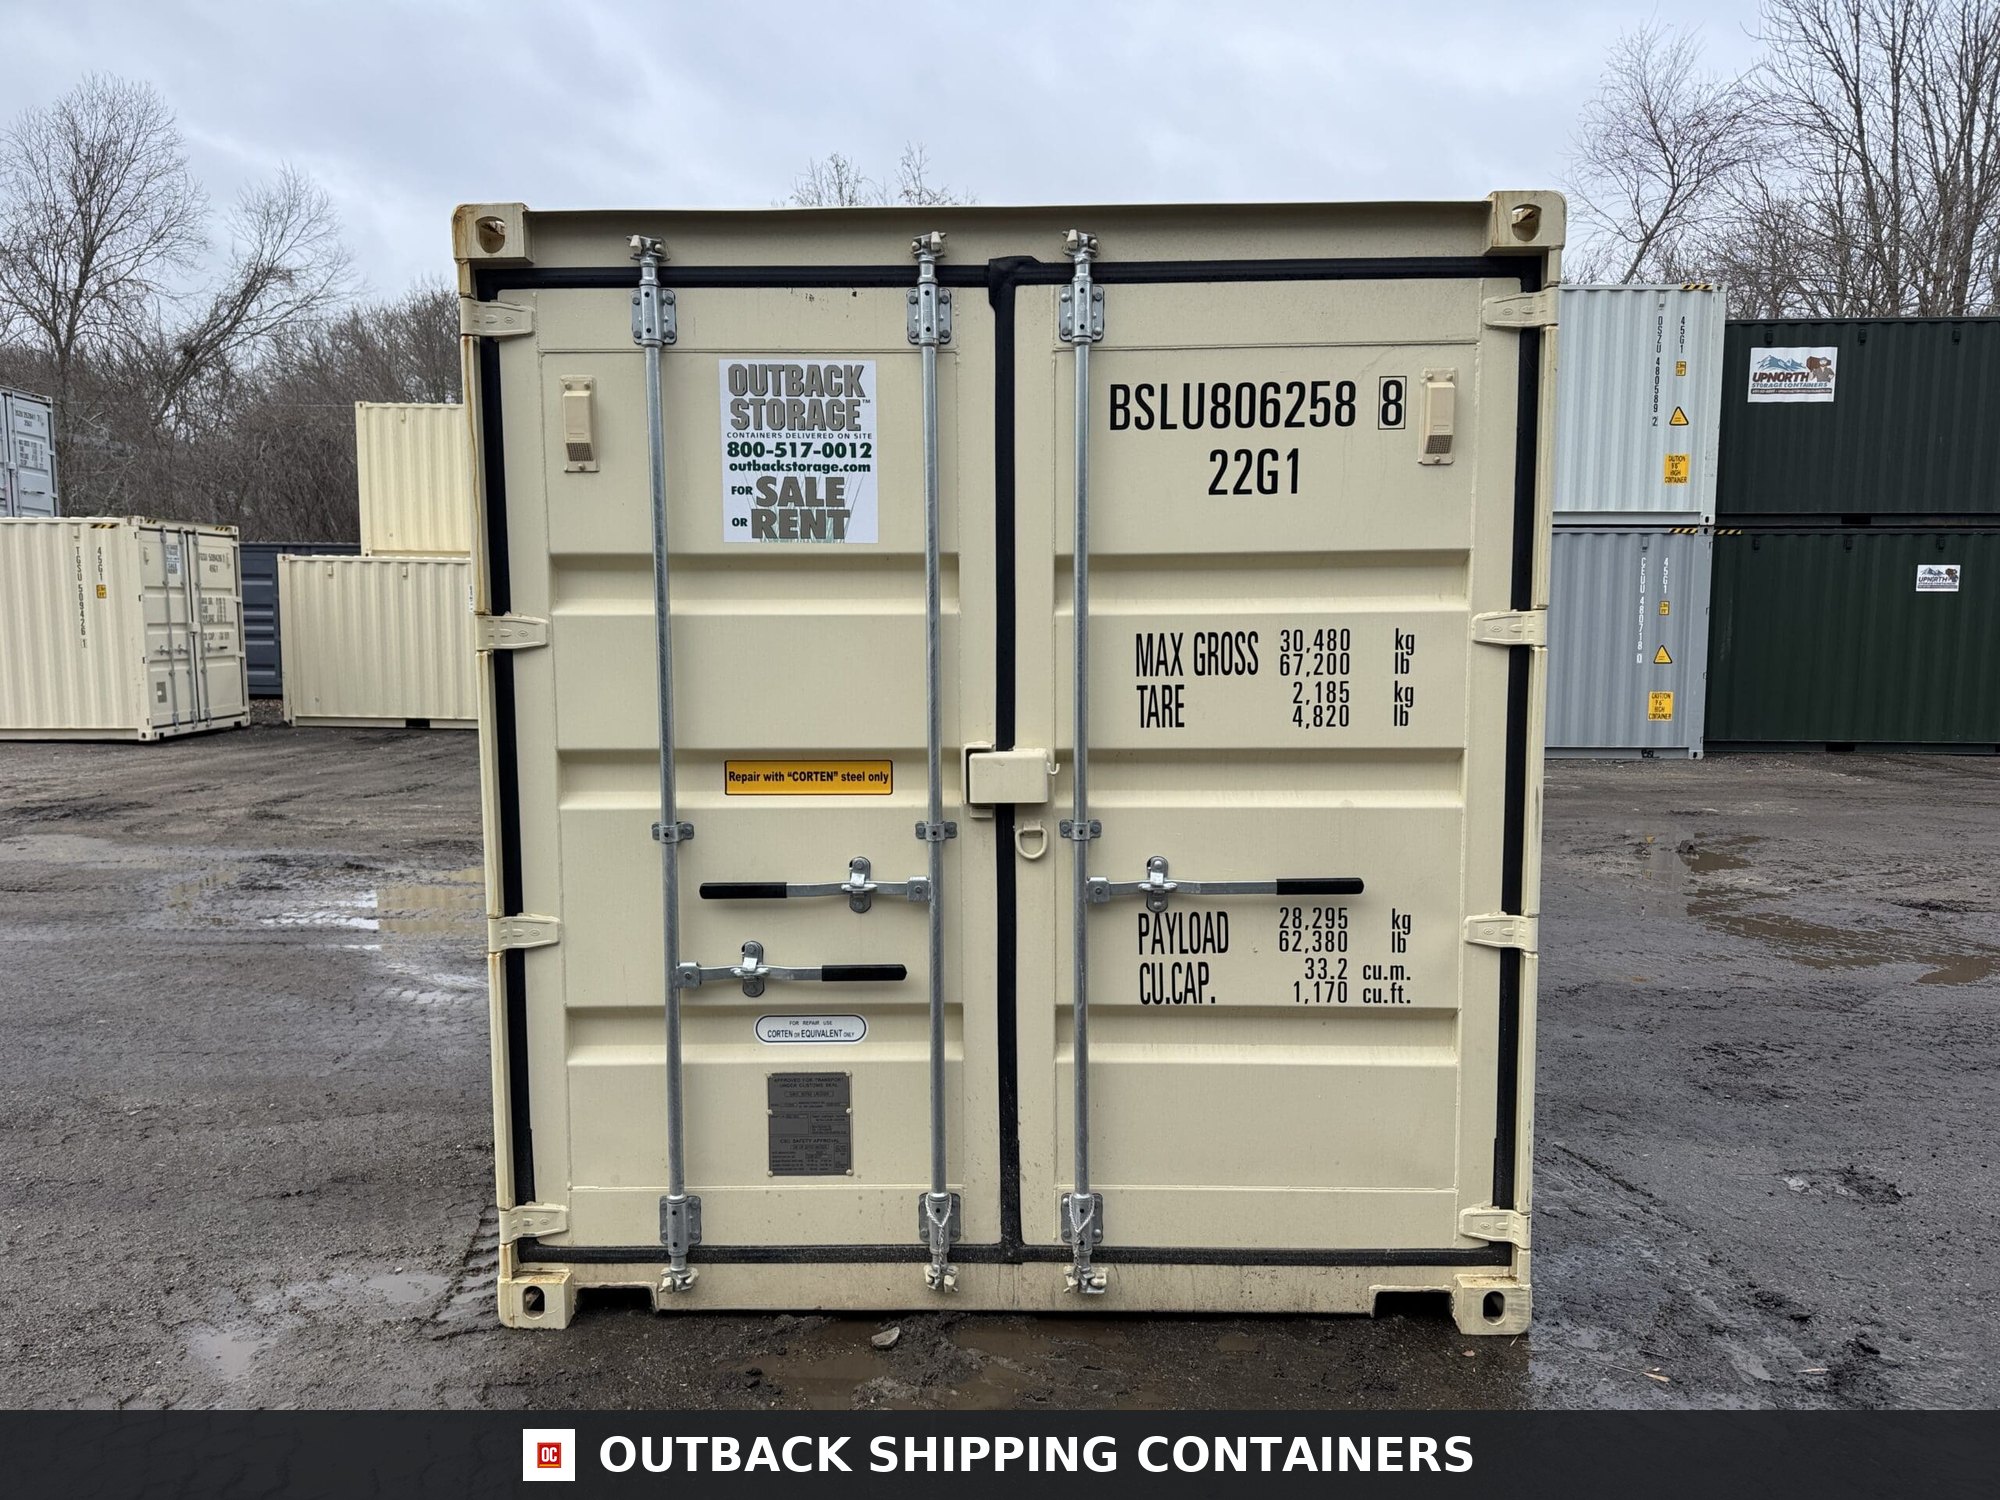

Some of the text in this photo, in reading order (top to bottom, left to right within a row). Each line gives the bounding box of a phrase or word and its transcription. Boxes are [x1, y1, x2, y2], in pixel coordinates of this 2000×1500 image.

[728, 364, 866, 398] OUTBACK
[1752, 372, 1809, 382] UPNORTH
[730, 398, 862, 432] STORAGE
[1109, 380, 1403, 431] BSLU806258 8
[727, 442, 872, 458] 800-517-0012
[729, 460, 871, 474] outbackstorage.com
[1208, 448, 1299, 496] 22G1
[731, 476, 845, 507] FOR SALE
[732, 508, 850, 540] OR RENT
[1136, 628, 1415, 677] MAX GROSS 30,480 kg
[1279, 652, 1410, 677] 67,200 lb
[1136, 680, 1414, 728] TARE 2,185 kg
[1292, 704, 1409, 729] 4,820 lb
[728, 771, 760, 784] Repair
[763, 771, 784, 782] with
[841, 771, 865, 782] steel
[868, 771, 889, 784] only
[1138, 907, 1412, 955] PAYLOAD 28,295 kg
[1279, 930, 1406, 954] 62,380 lb
[1139, 958, 1411, 1005] CU.CAP. 33.2 cu.m.
[1293, 981, 1411, 1004] 1,170 cu.ft.
[767, 1030, 793, 1038] CORTEN
[801, 1029, 843, 1038] EQUIVALENT
